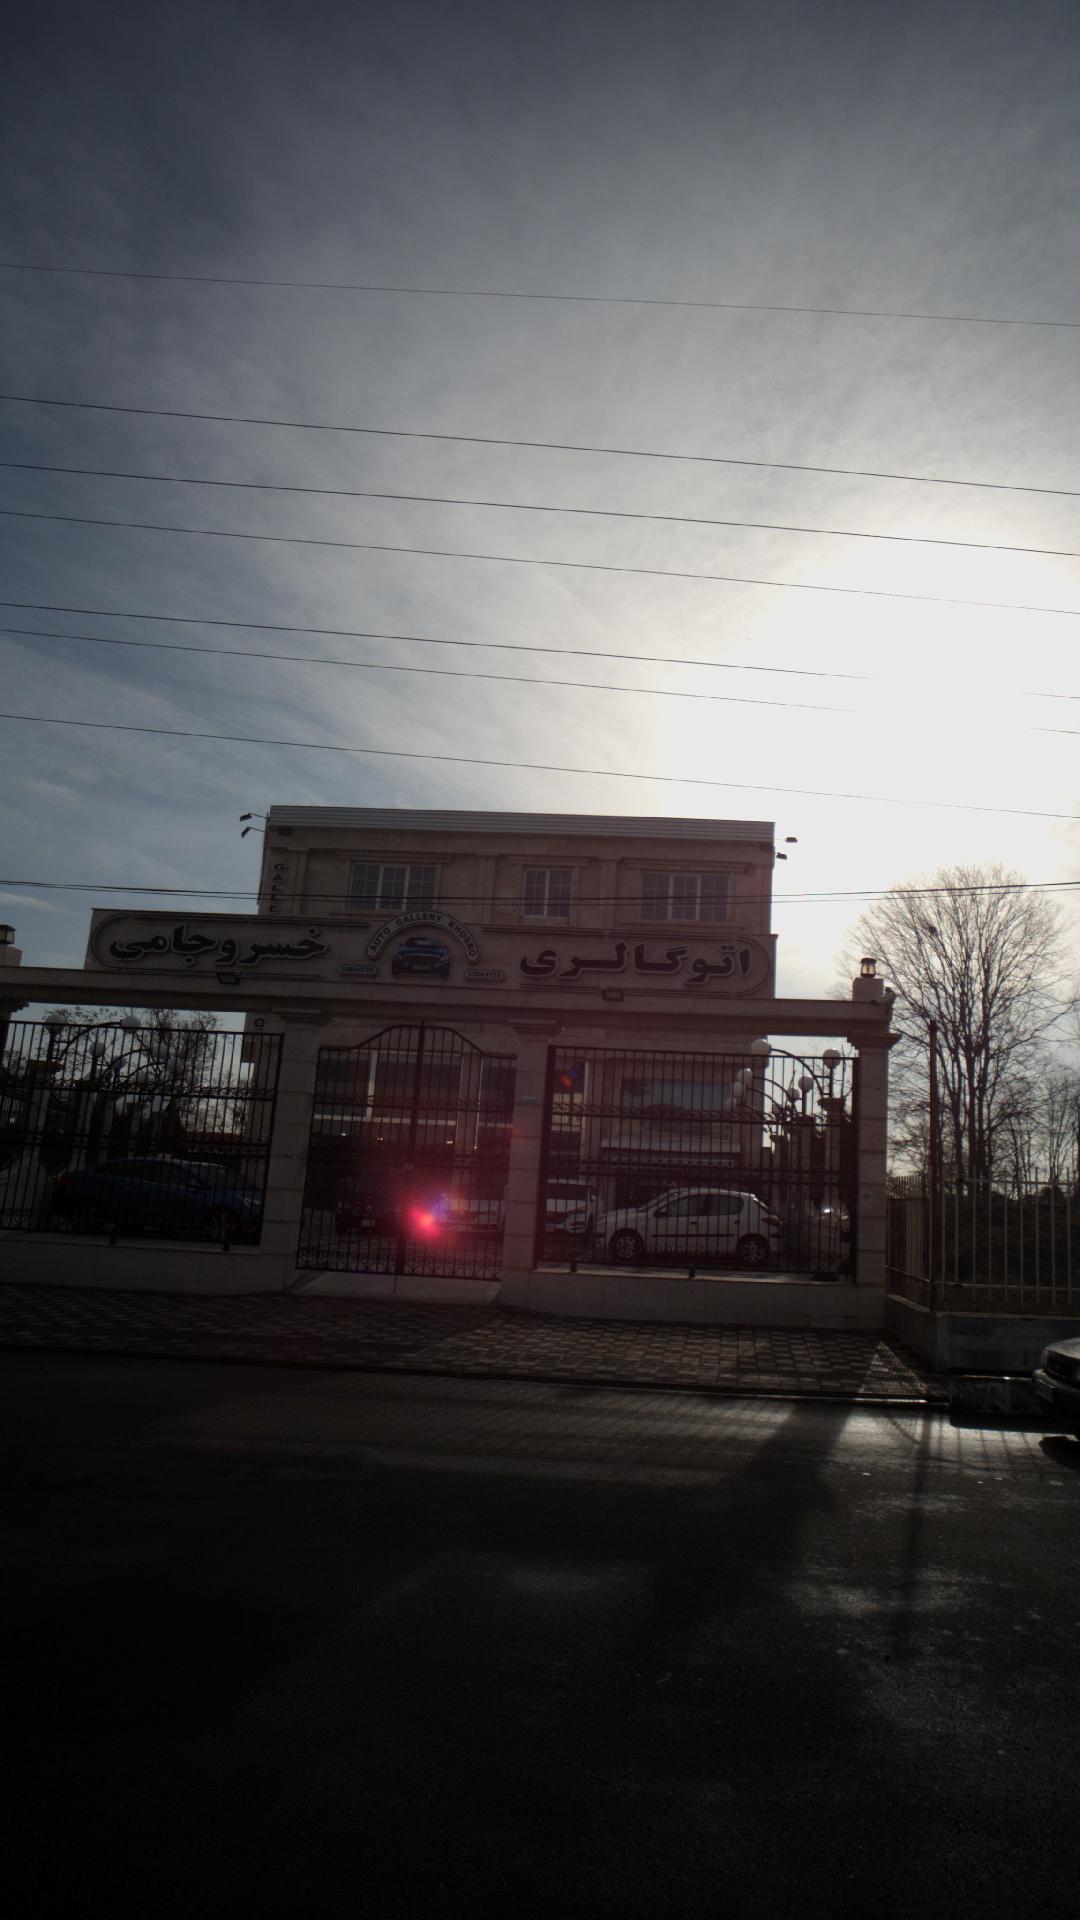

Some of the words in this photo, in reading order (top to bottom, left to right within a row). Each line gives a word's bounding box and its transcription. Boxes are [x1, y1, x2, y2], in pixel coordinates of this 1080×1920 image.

[369, 926, 392, 953] AUTO
[396, 912, 443, 927] GALLERY
[448, 920, 477, 957] KHOSRO
